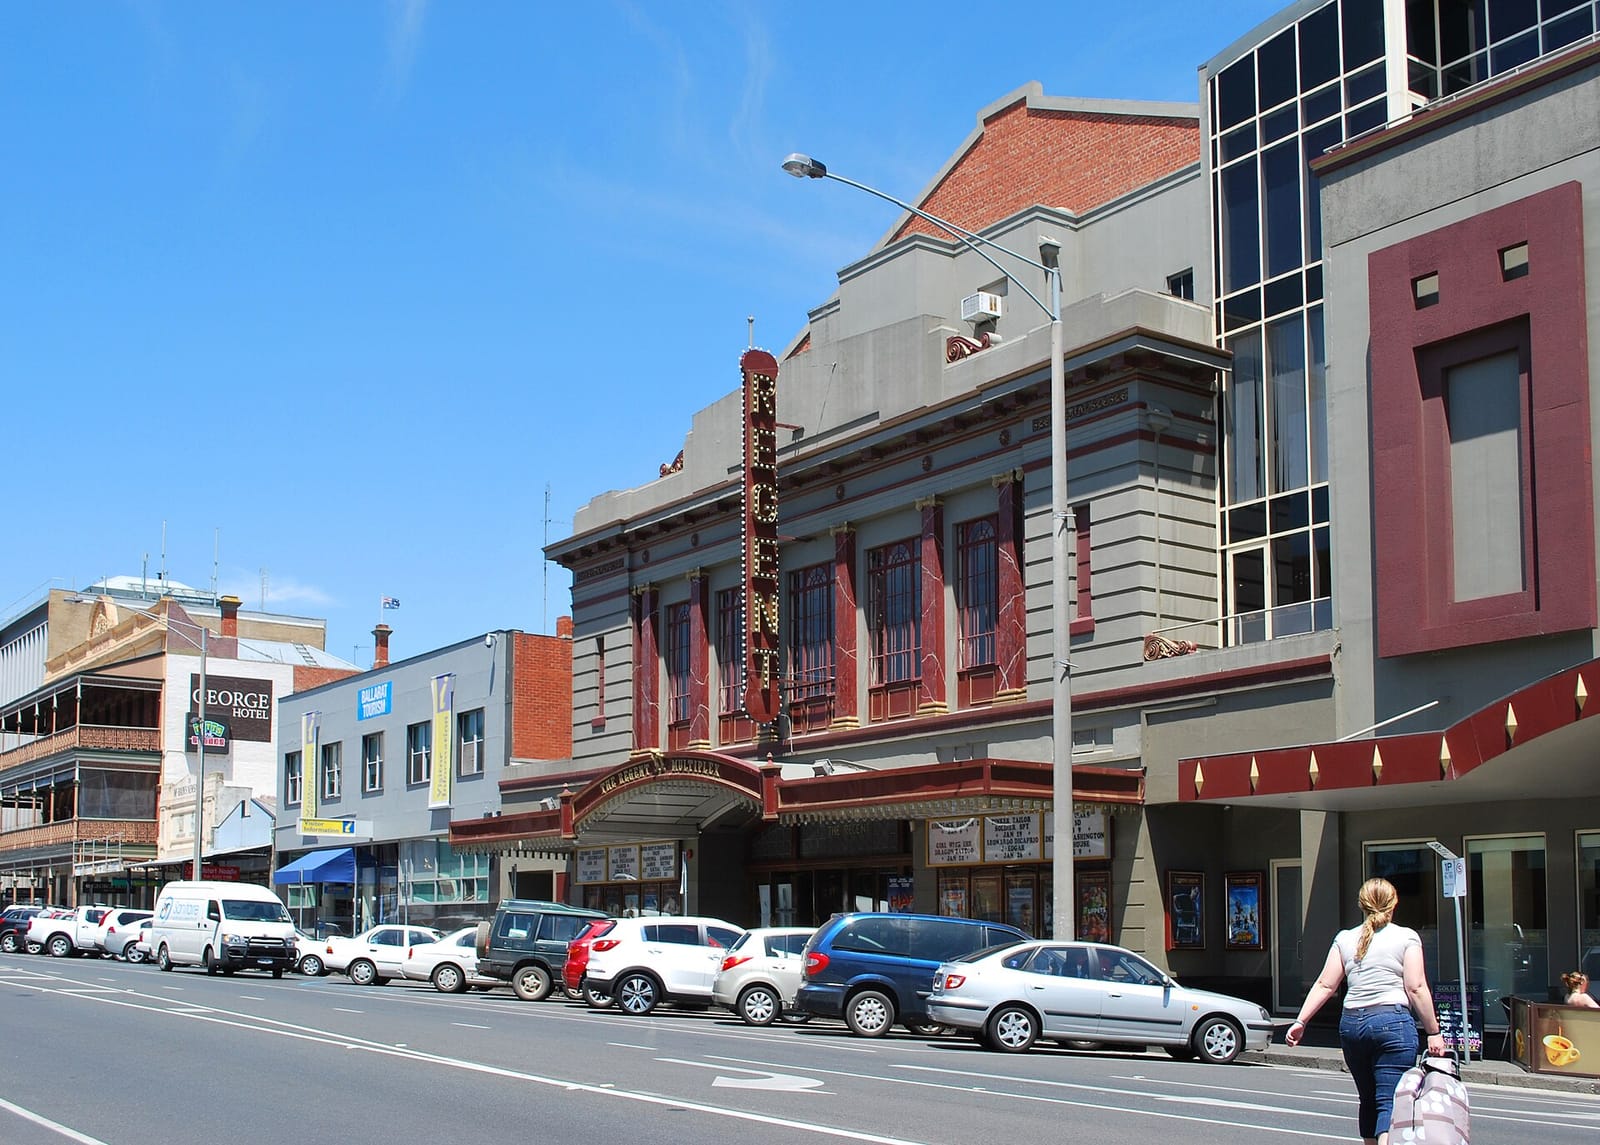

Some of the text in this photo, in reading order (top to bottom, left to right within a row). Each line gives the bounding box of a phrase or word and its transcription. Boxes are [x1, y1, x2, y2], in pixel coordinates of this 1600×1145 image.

[751, 373, 777, 689] REGENT
[193, 688, 269, 709] GEORGE
[361, 684, 388, 704] BALLARAT
[232, 708, 269, 719] HOTEL
[362, 699, 387, 718] TOURISM
[600, 759, 720, 795] THE REGENT MULTIPLEX
[303, 826, 340, 834] Information
[1073, 832, 1105, 841] ASHINGTON
[986, 838, 1013, 846] LEONARDO
[1444, 862, 1453, 872] 1P
